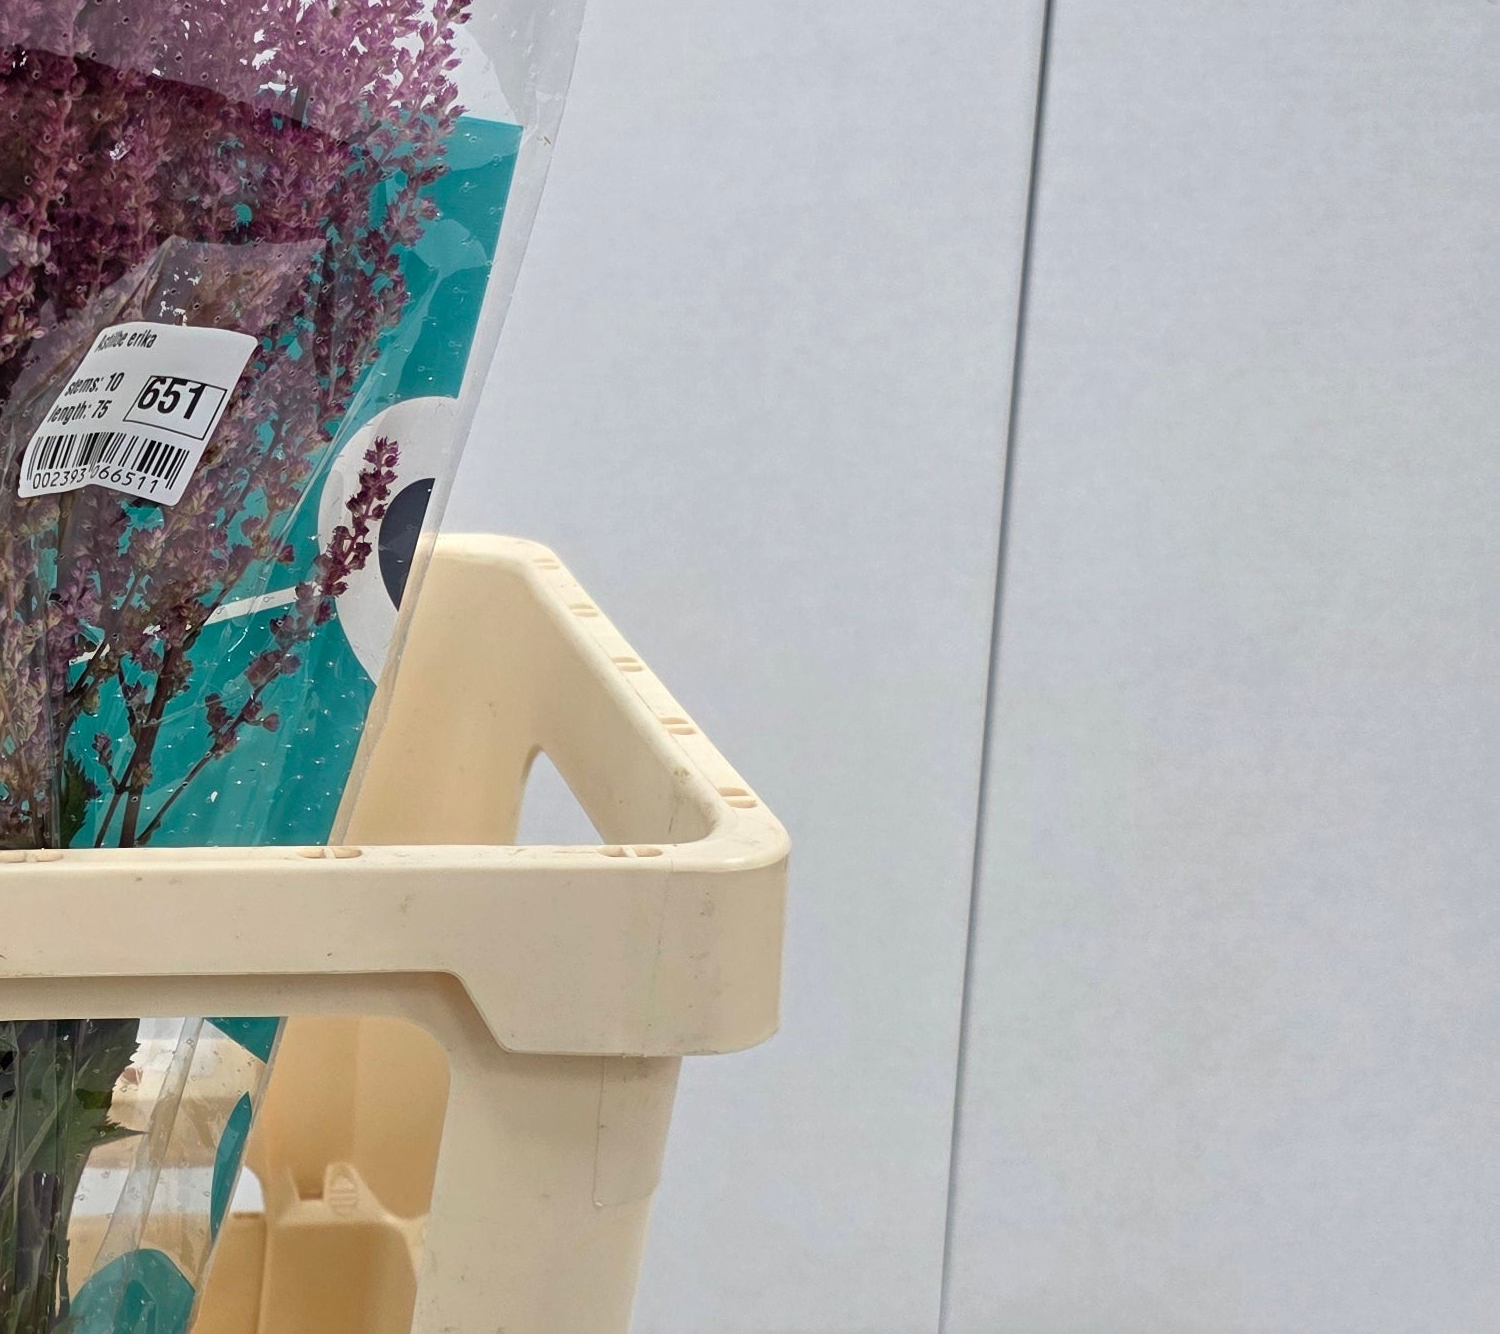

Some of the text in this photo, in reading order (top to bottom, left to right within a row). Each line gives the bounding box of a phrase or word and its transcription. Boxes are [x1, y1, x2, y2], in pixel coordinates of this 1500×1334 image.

[127, 329, 157, 348] erika
[64, 372, 125, 396] stems: 10
[137, 376, 206, 420] 651
[47, 400, 112, 425] length: 75
